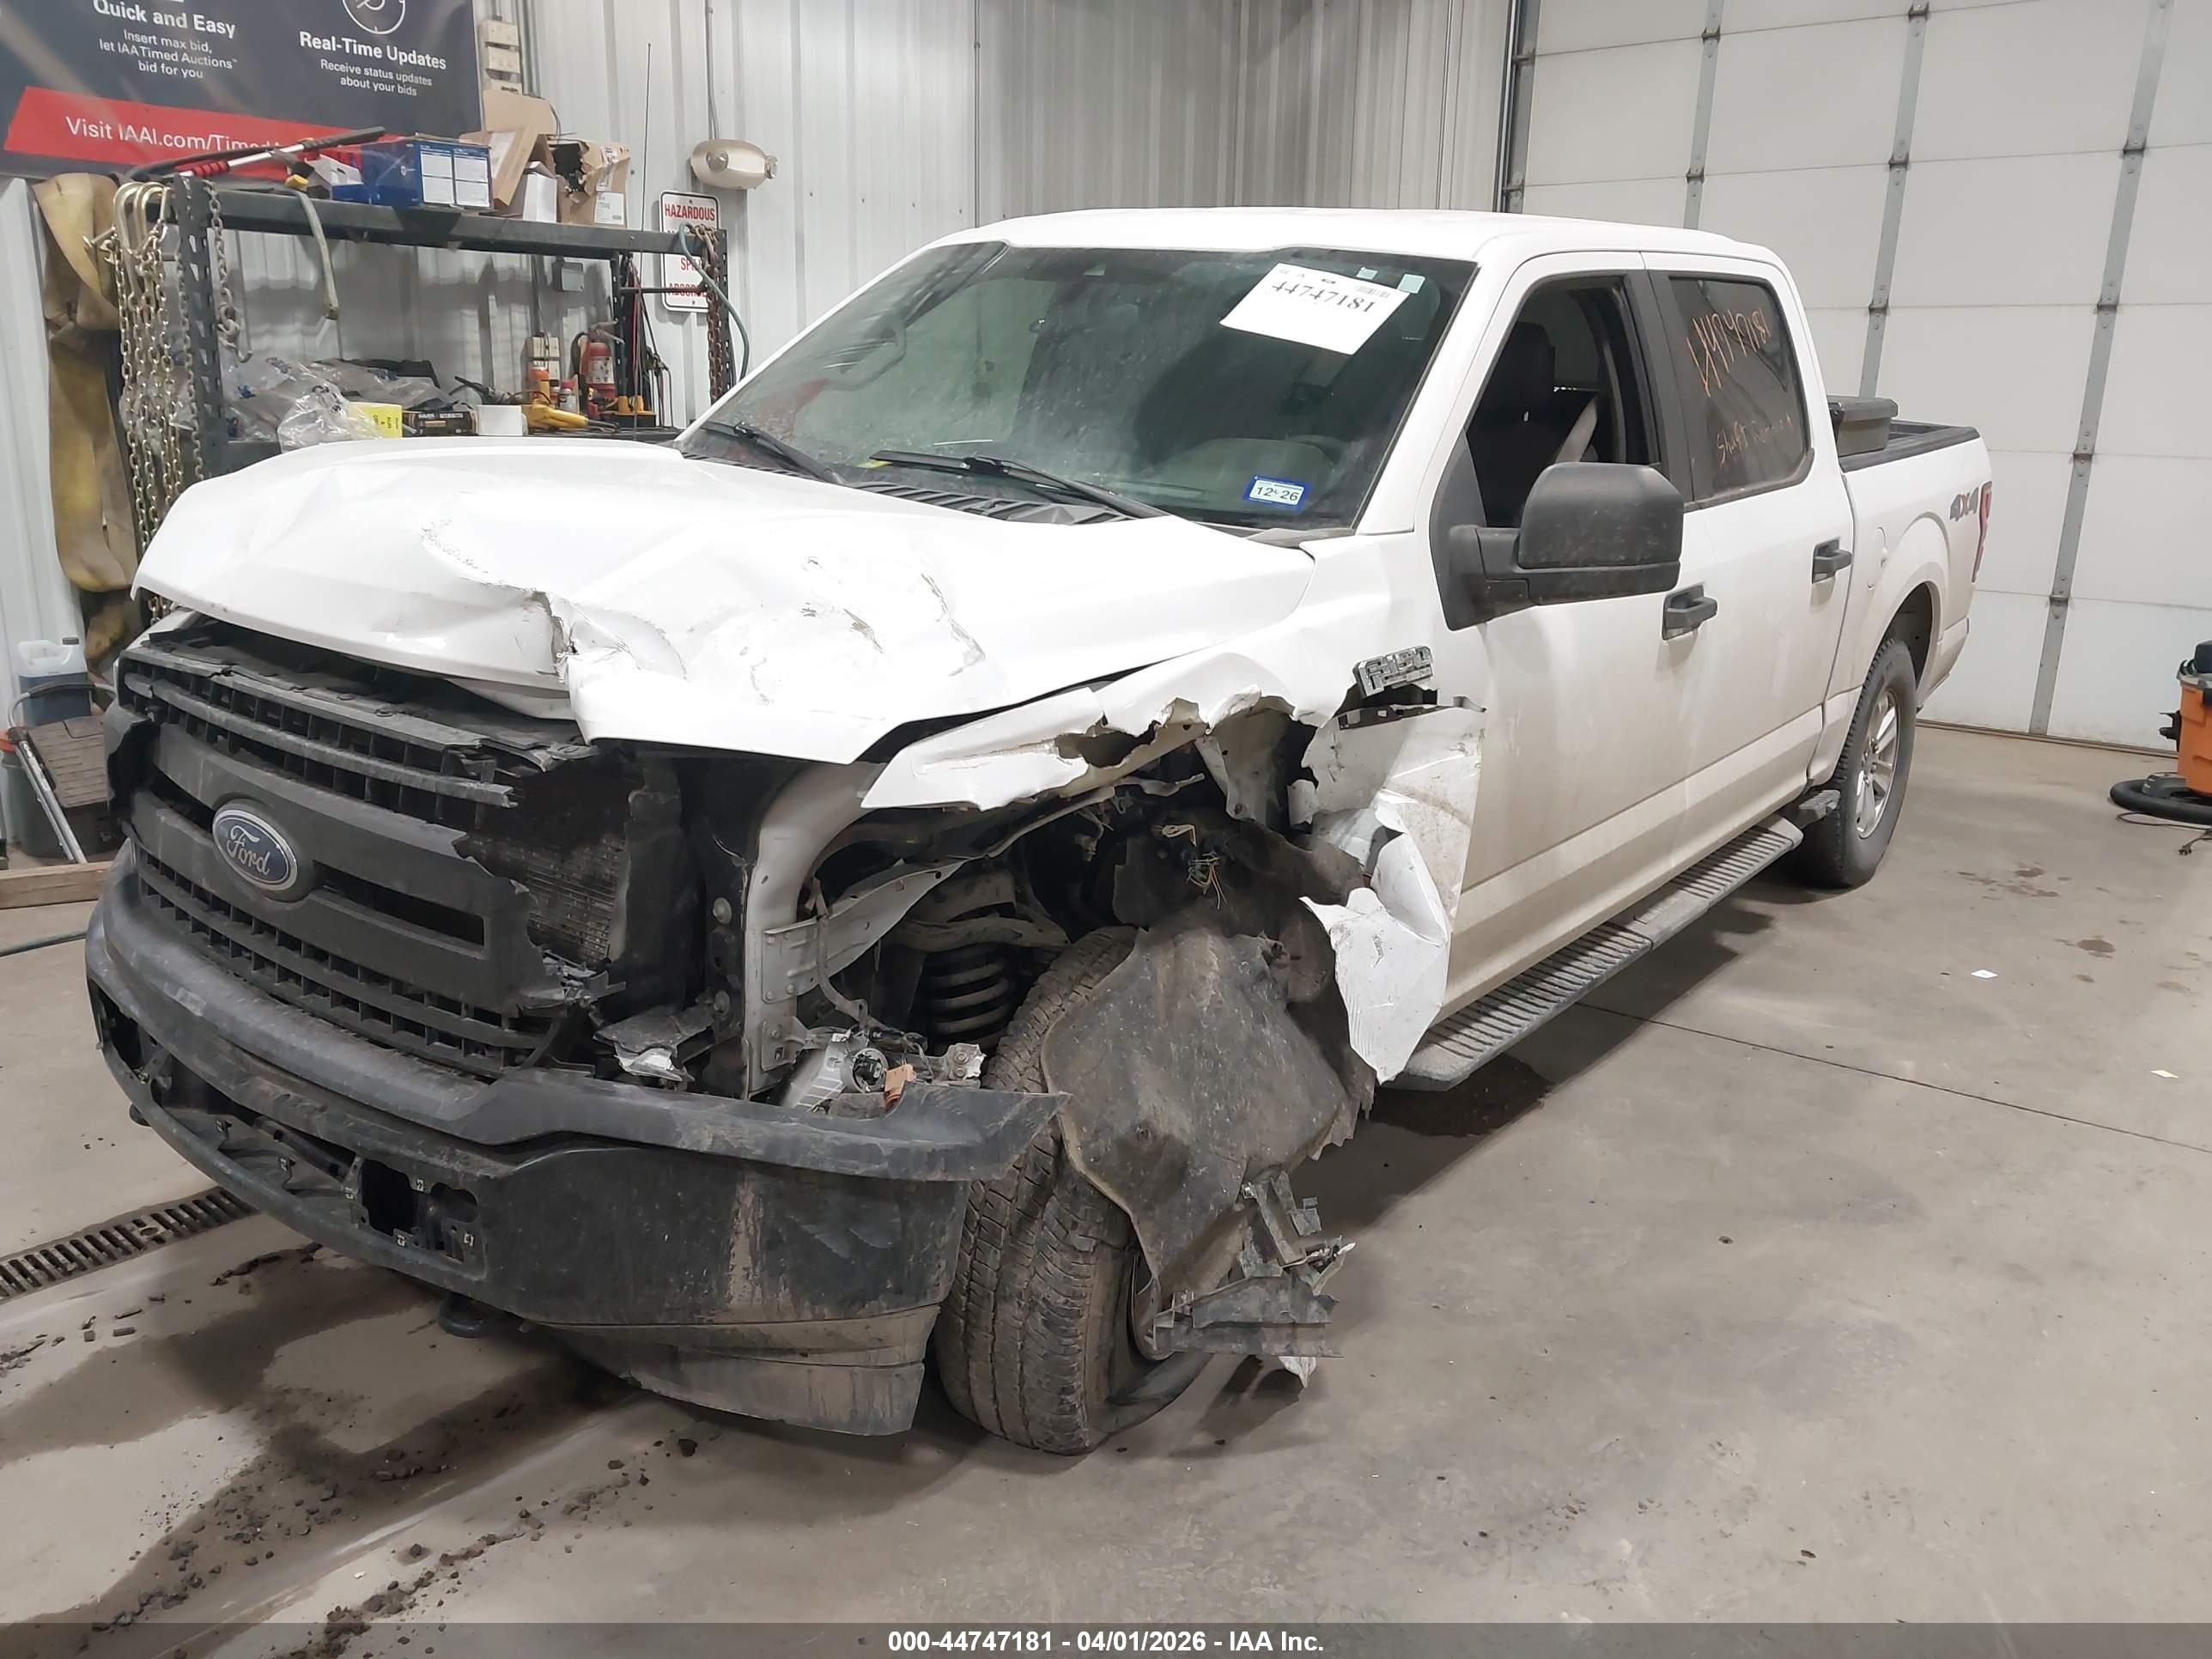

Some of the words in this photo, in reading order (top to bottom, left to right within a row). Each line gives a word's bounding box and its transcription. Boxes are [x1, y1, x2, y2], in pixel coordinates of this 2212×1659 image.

[93, 0, 148, 22] Quick
[153, 11, 187, 29] and
[193, 14, 236, 39] Easy
[99, 39, 115, 52] let
[124, 28, 158, 46] Insert
[161, 37, 186, 50] max
[190, 40, 213, 54] bid,
[300, 31, 382, 58] Real-Time
[386, 45, 447, 70] Updates
[138, 60, 157, 73] bid
[161, 63, 178, 76] for
[181, 68, 204, 79] you
[320, 58, 362, 75] Receive
[364, 67, 393, 80] status
[396, 71, 432, 87] updates
[340, 76, 370, 89] about
[373, 82, 395, 92] your
[398, 83, 417, 96] bids
[66, 116, 112, 139] Visit
[665, 204, 715, 221] HAZARDOUS
[1272, 281, 1376, 313] 44747181
[227, 824, 270, 875] Ford
